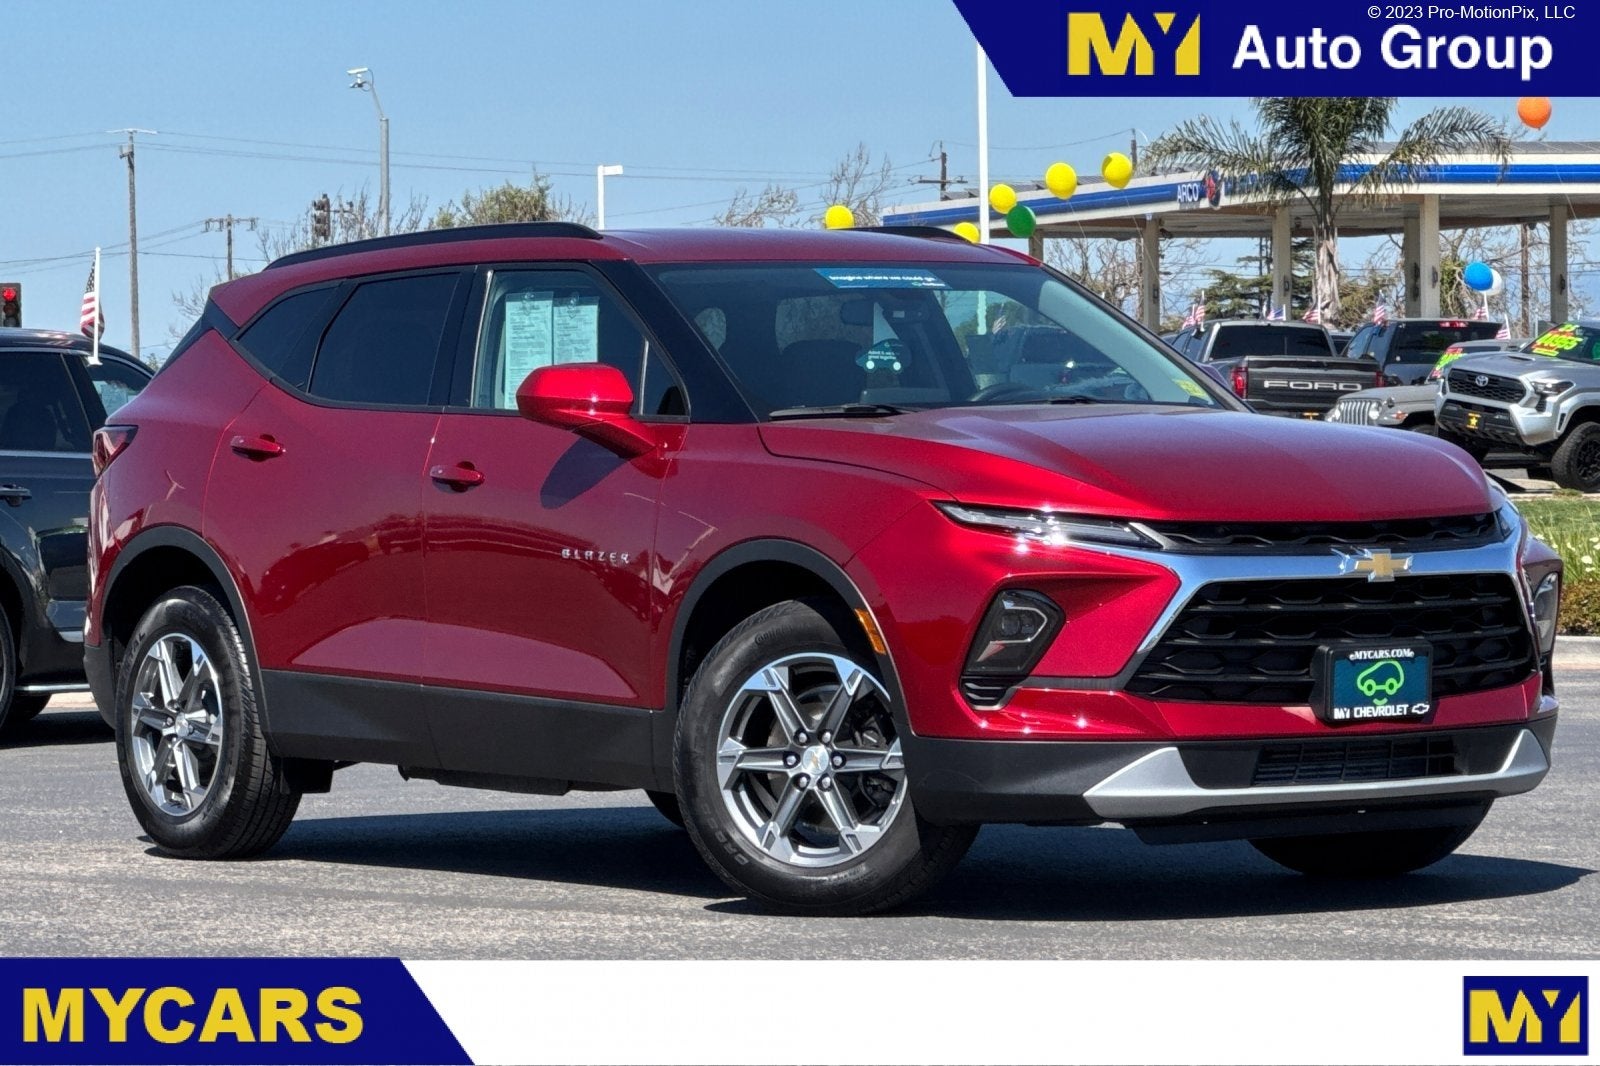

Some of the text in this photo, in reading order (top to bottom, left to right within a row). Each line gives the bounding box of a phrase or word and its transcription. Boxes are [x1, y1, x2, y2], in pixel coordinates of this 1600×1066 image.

[1177, 183, 1199, 202] ARCO
[1263, 380, 1362, 391] FORD
[561, 548, 629, 564] BLAZER
[1333, 704, 1409, 720] MY CHEVROLET
